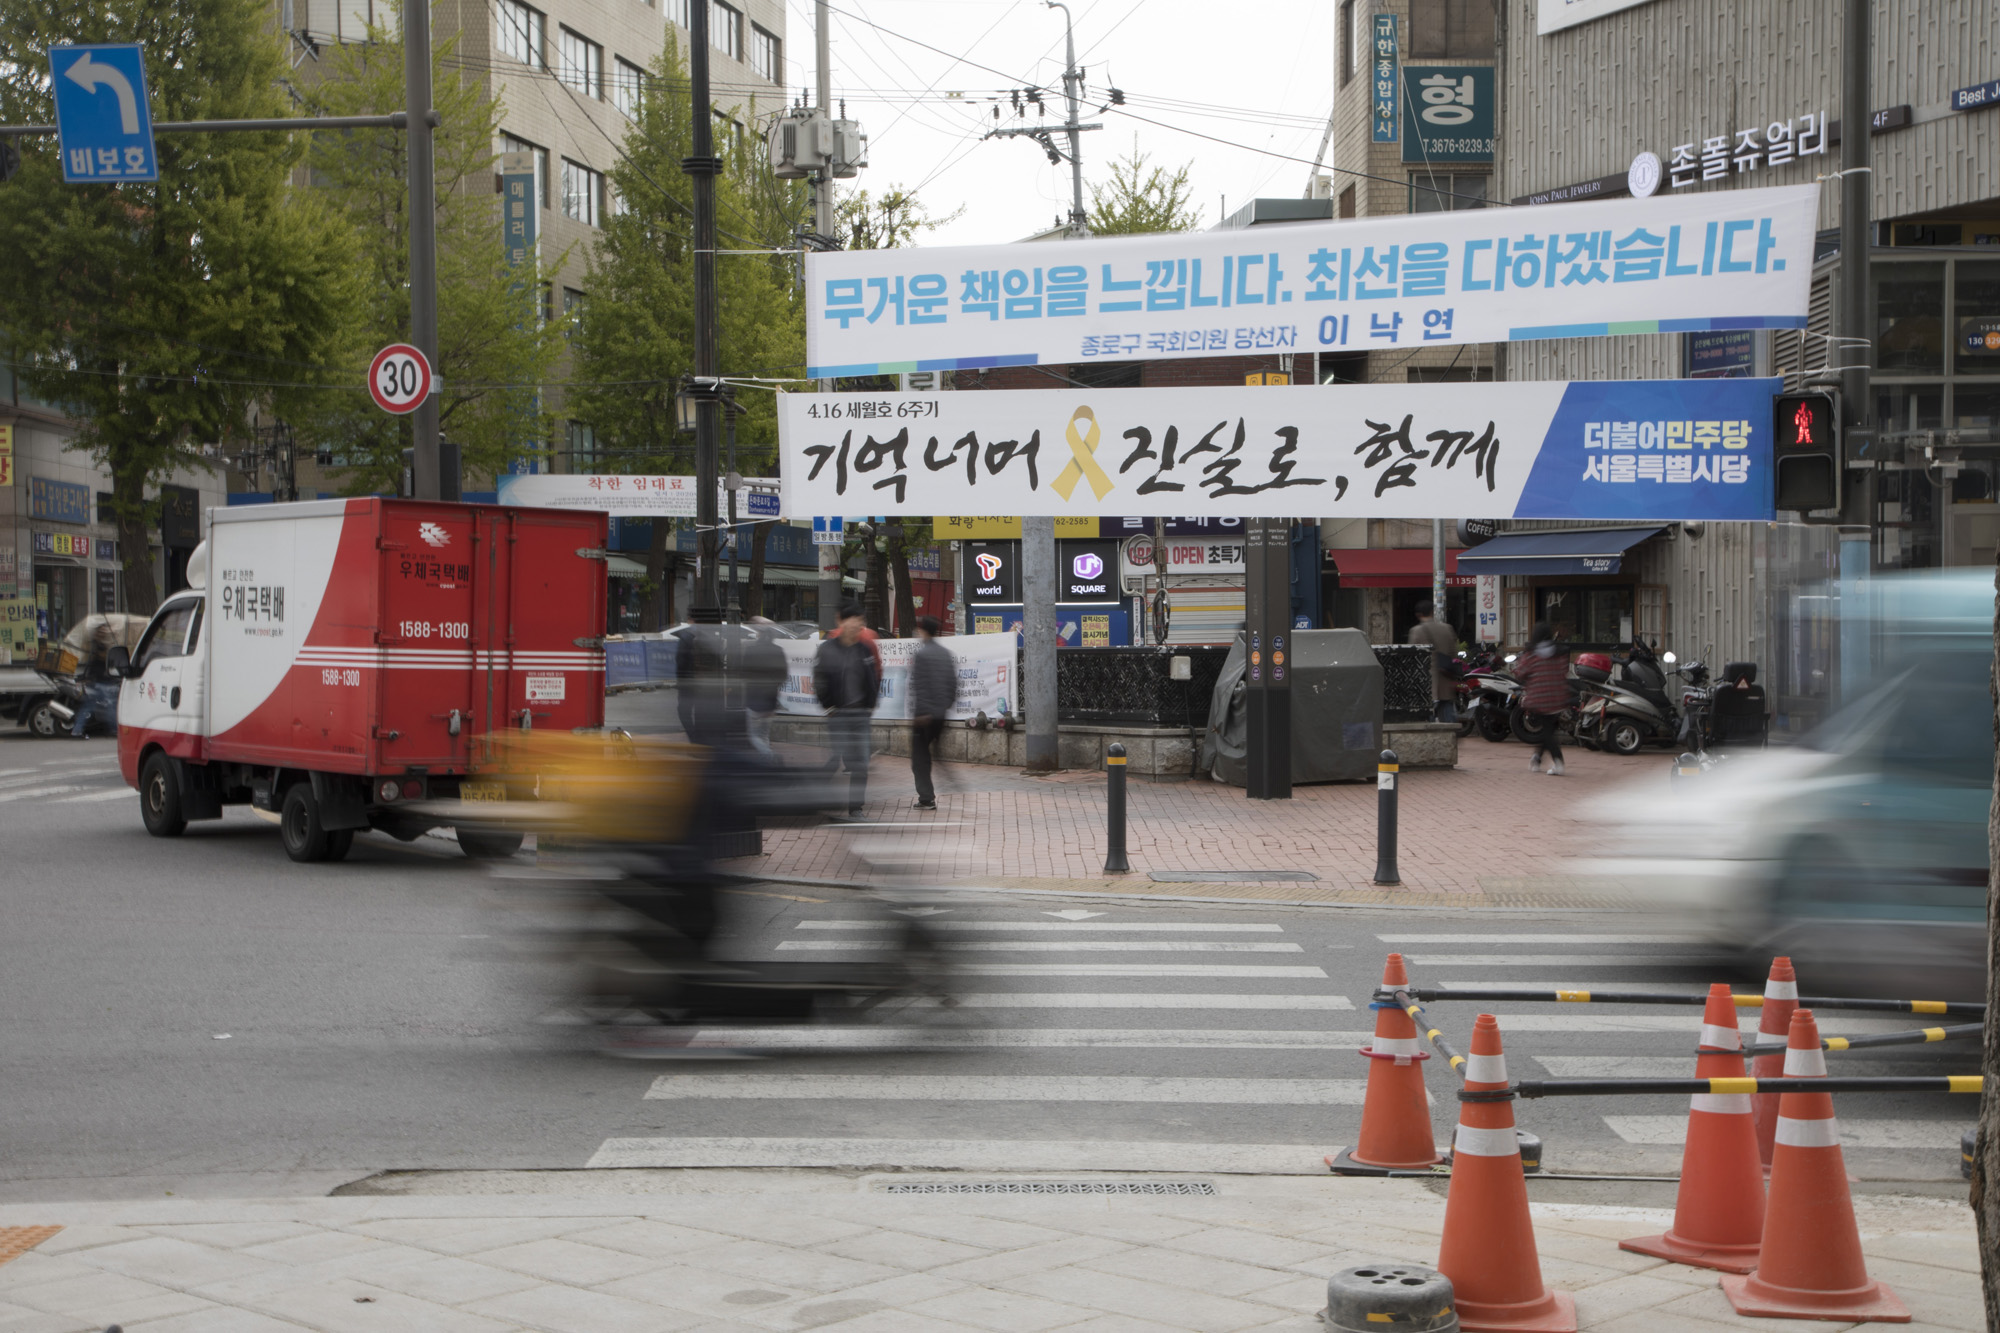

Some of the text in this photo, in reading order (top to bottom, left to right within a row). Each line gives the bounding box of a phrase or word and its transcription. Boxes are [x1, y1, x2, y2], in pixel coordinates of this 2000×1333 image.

[1377, 18, 1394, 139] 규한종합상사
[1419, 73, 1475, 126] 형
[1959, 82, 2000, 106] Best J
[1873, 111, 1888, 127] 4F
[1670, 110, 1826, 188] 존폴쥬얼리
[69, 146, 149, 177] 비보호
[1528, 181, 1602, 206] JOHN PAUL JEWELRY
[511, 182, 524, 237] 메틀러
[824, 217, 1787, 329] 무거운 책임을 느낍니다. 최선을 다하겠습니다.
[1080, 324, 1298, 357] 종로구 국회의원 당선자
[1968, 336, 1983, 345] 130
[382, 360, 417, 397] 30
[808, 400, 940, 420] 4.16 세월호 6주기
[1584, 420, 1753, 450] 더불어민주당
[803, 413, 1502, 504] 기억 너머 진실로, 함께
[1582, 453, 1752, 485] 서울특별시당
[588, 477, 686, 491] 착한 임대료
[949, 516, 974, 529] 화랑
[1053, 517, 1089, 526] 62-2585
[1467, 522, 1494, 536] COFFEE
[813, 532, 842, 542] 일방통행
[1173, 545, 1205, 564] OPEN
[1208, 545, 1246, 564] 초특가
[1583, 558, 1611, 567] Tea story
[400, 561, 470, 582] 우체국택배
[976, 585, 1002, 595] world
[1070, 585, 1106, 595] SQUARE
[8, 604, 35, 621] 인쇄
[222, 585, 285, 622] 우체국택배
[1296, 621, 1309, 629] ADT
[1479, 612, 1498, 625] 입구
[399, 621, 469, 639] 1588-1300
[322, 668, 360, 687] 1588-1300
